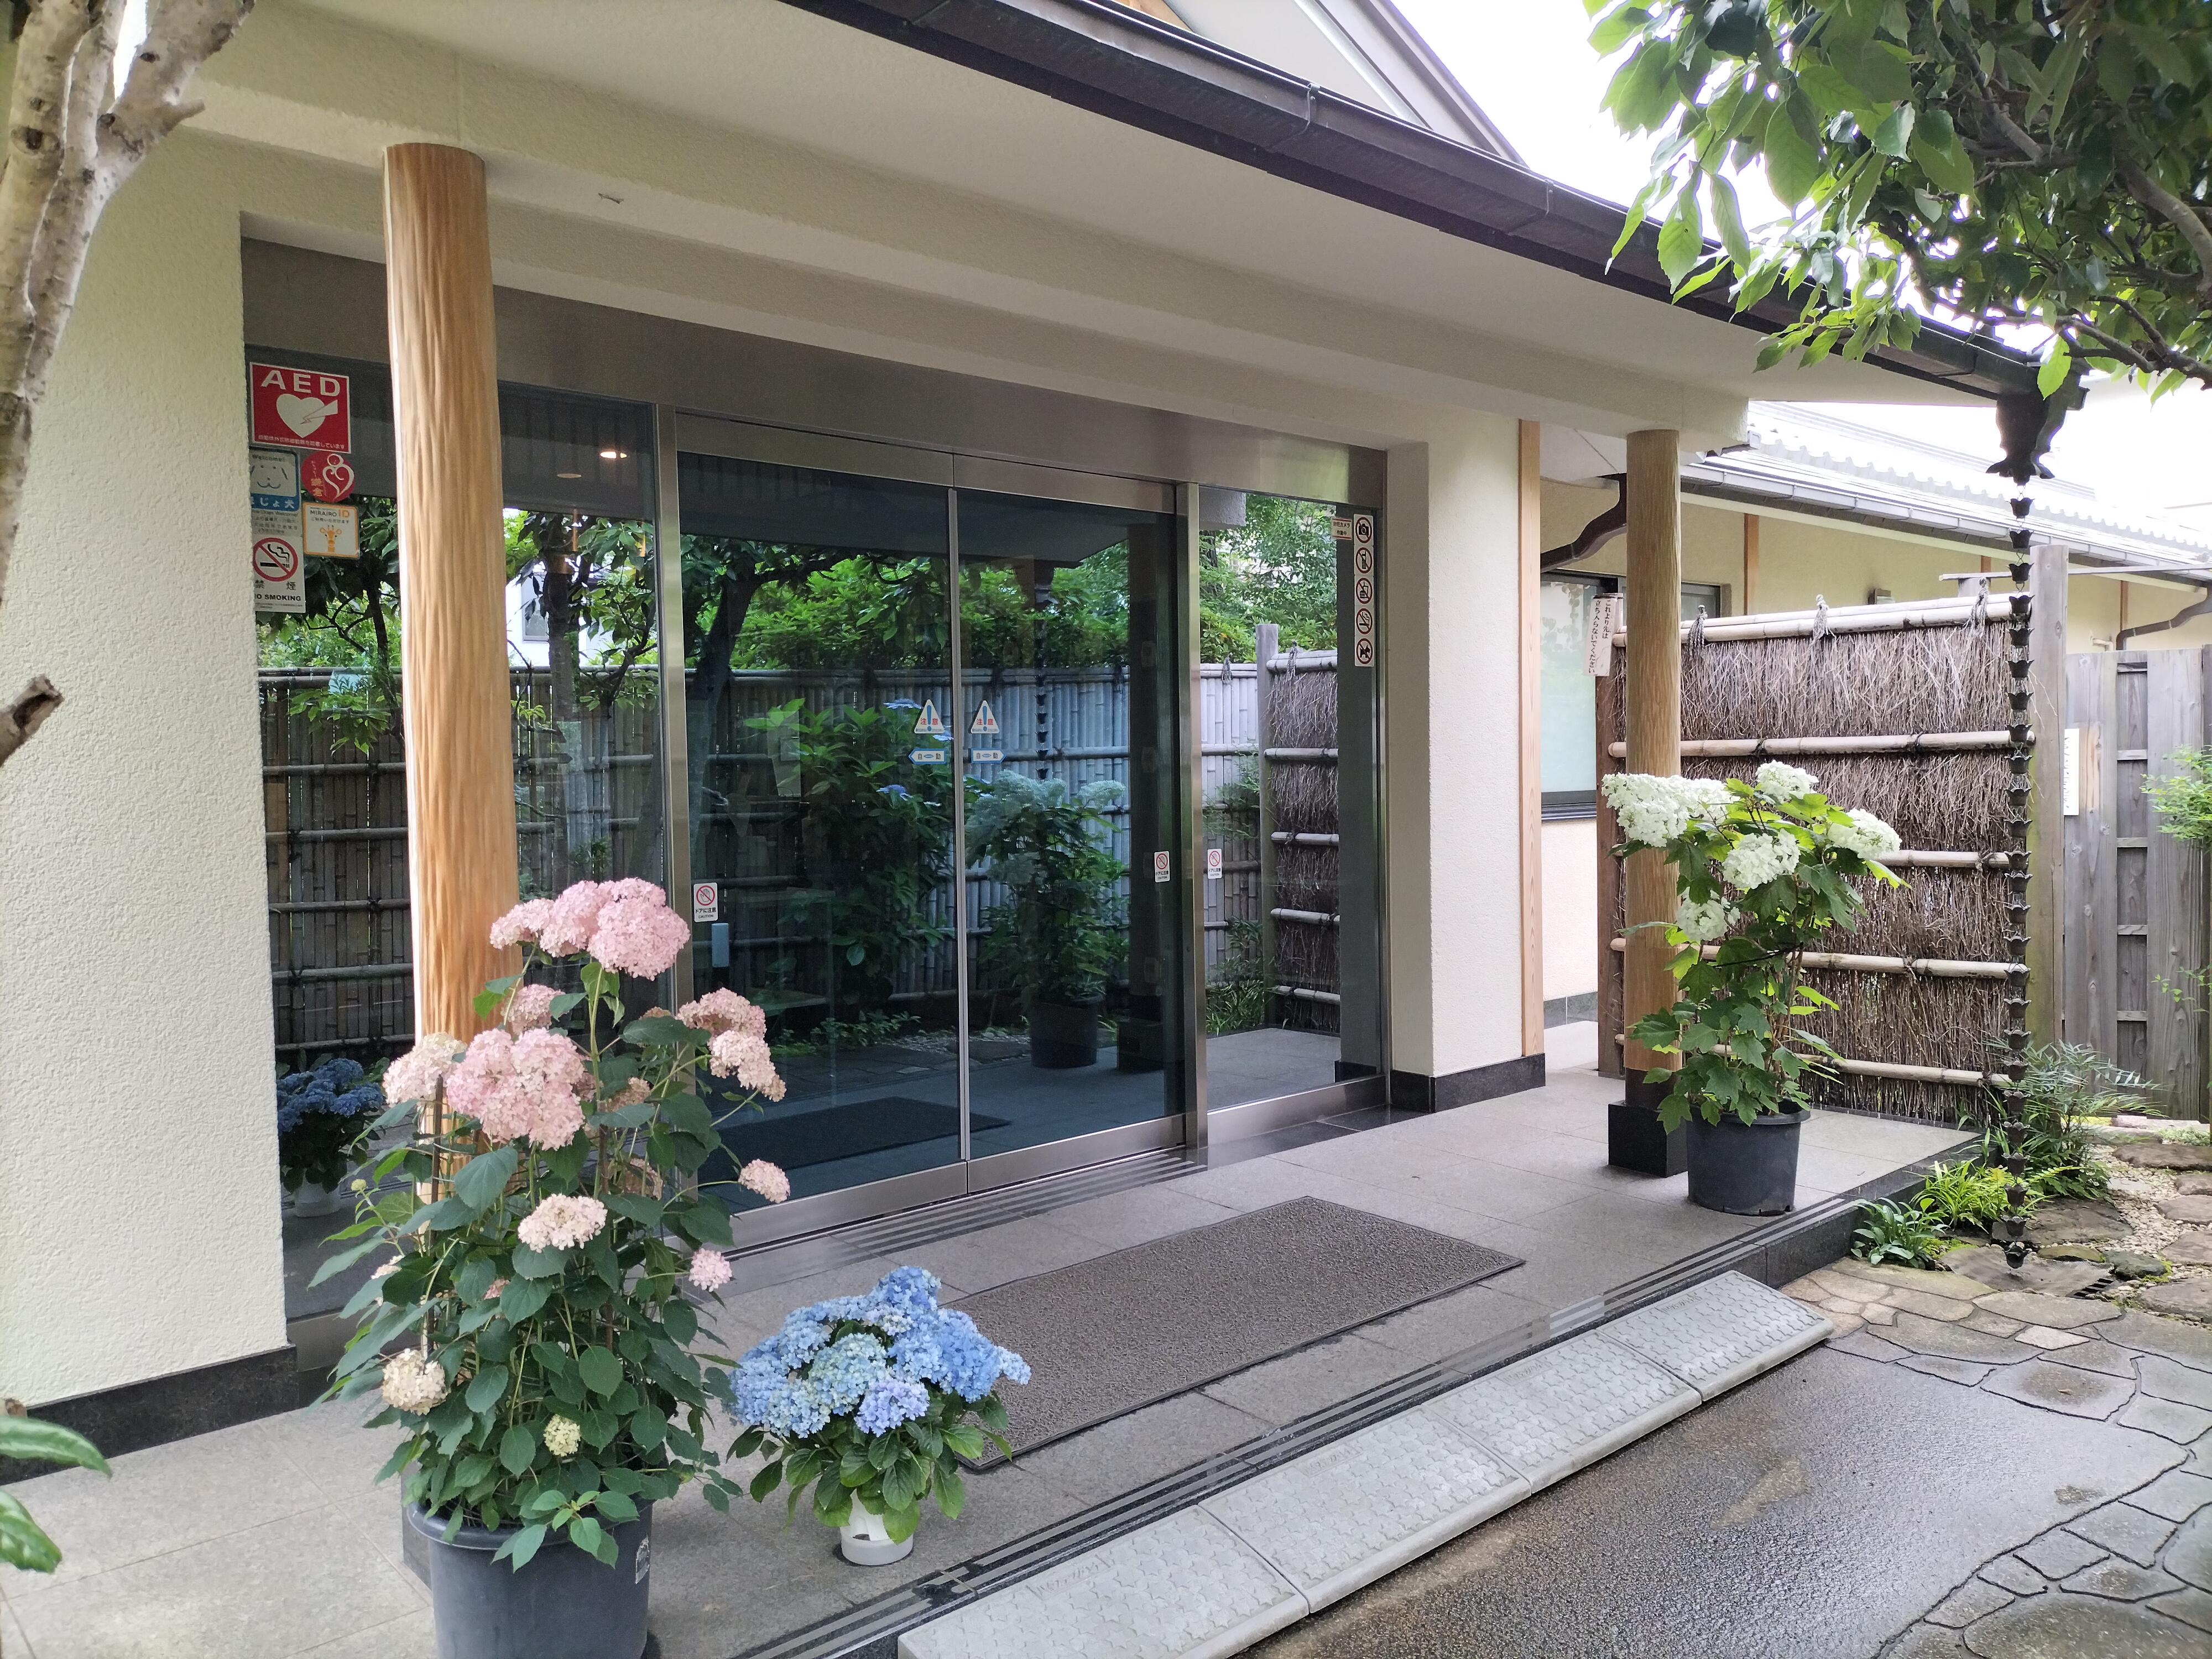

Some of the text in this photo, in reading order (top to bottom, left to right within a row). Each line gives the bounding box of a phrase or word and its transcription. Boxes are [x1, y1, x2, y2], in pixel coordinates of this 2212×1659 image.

[260, 370, 341, 397] AED
[338, 509, 349, 518] ID
[1602, 600, 1611, 639] これより先は
[1588, 600, 1601, 674] 立ち入らないでください
